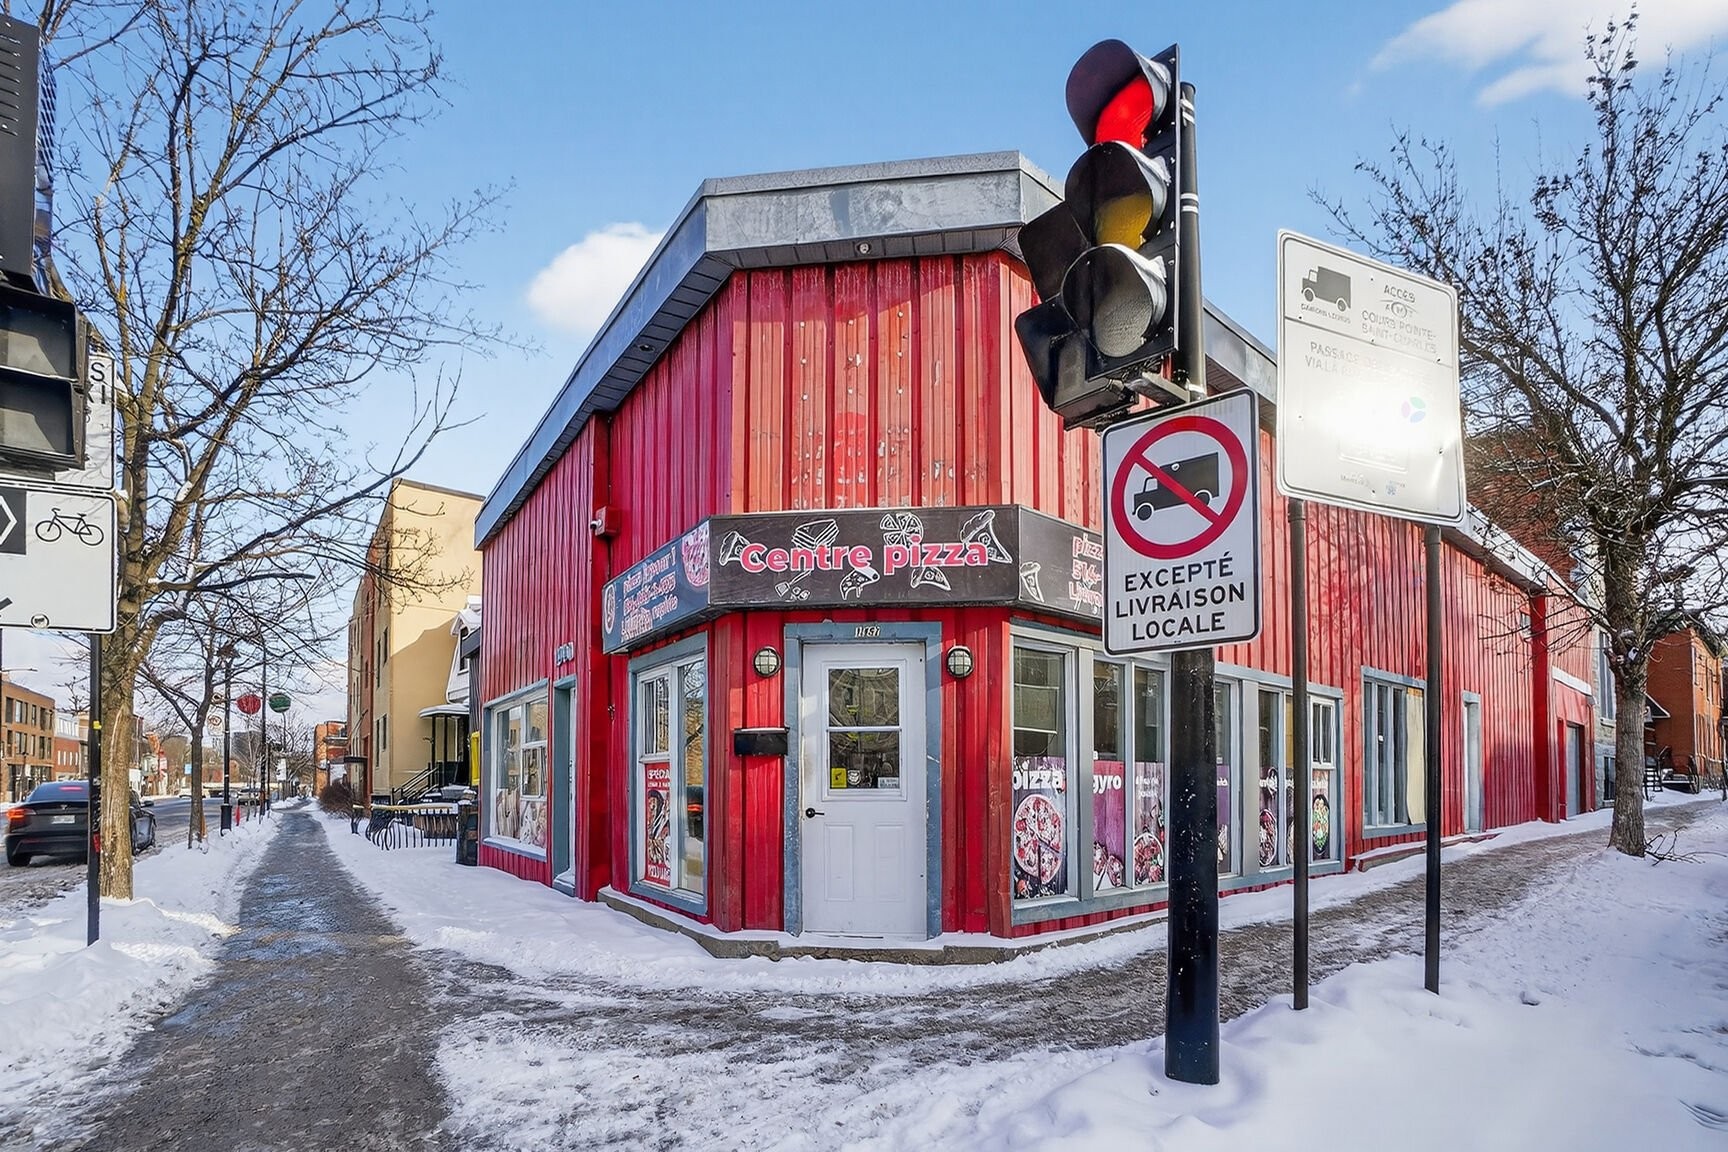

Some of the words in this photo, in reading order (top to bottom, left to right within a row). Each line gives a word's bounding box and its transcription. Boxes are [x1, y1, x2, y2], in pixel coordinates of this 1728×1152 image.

[740, 543, 873, 573] Centre
[883, 534, 989, 576] pizza
[1124, 551, 1234, 593] EXCEPTÉ
[1116, 582, 1245, 618] LIVRAISON
[1132, 612, 1226, 641] LOCALE
